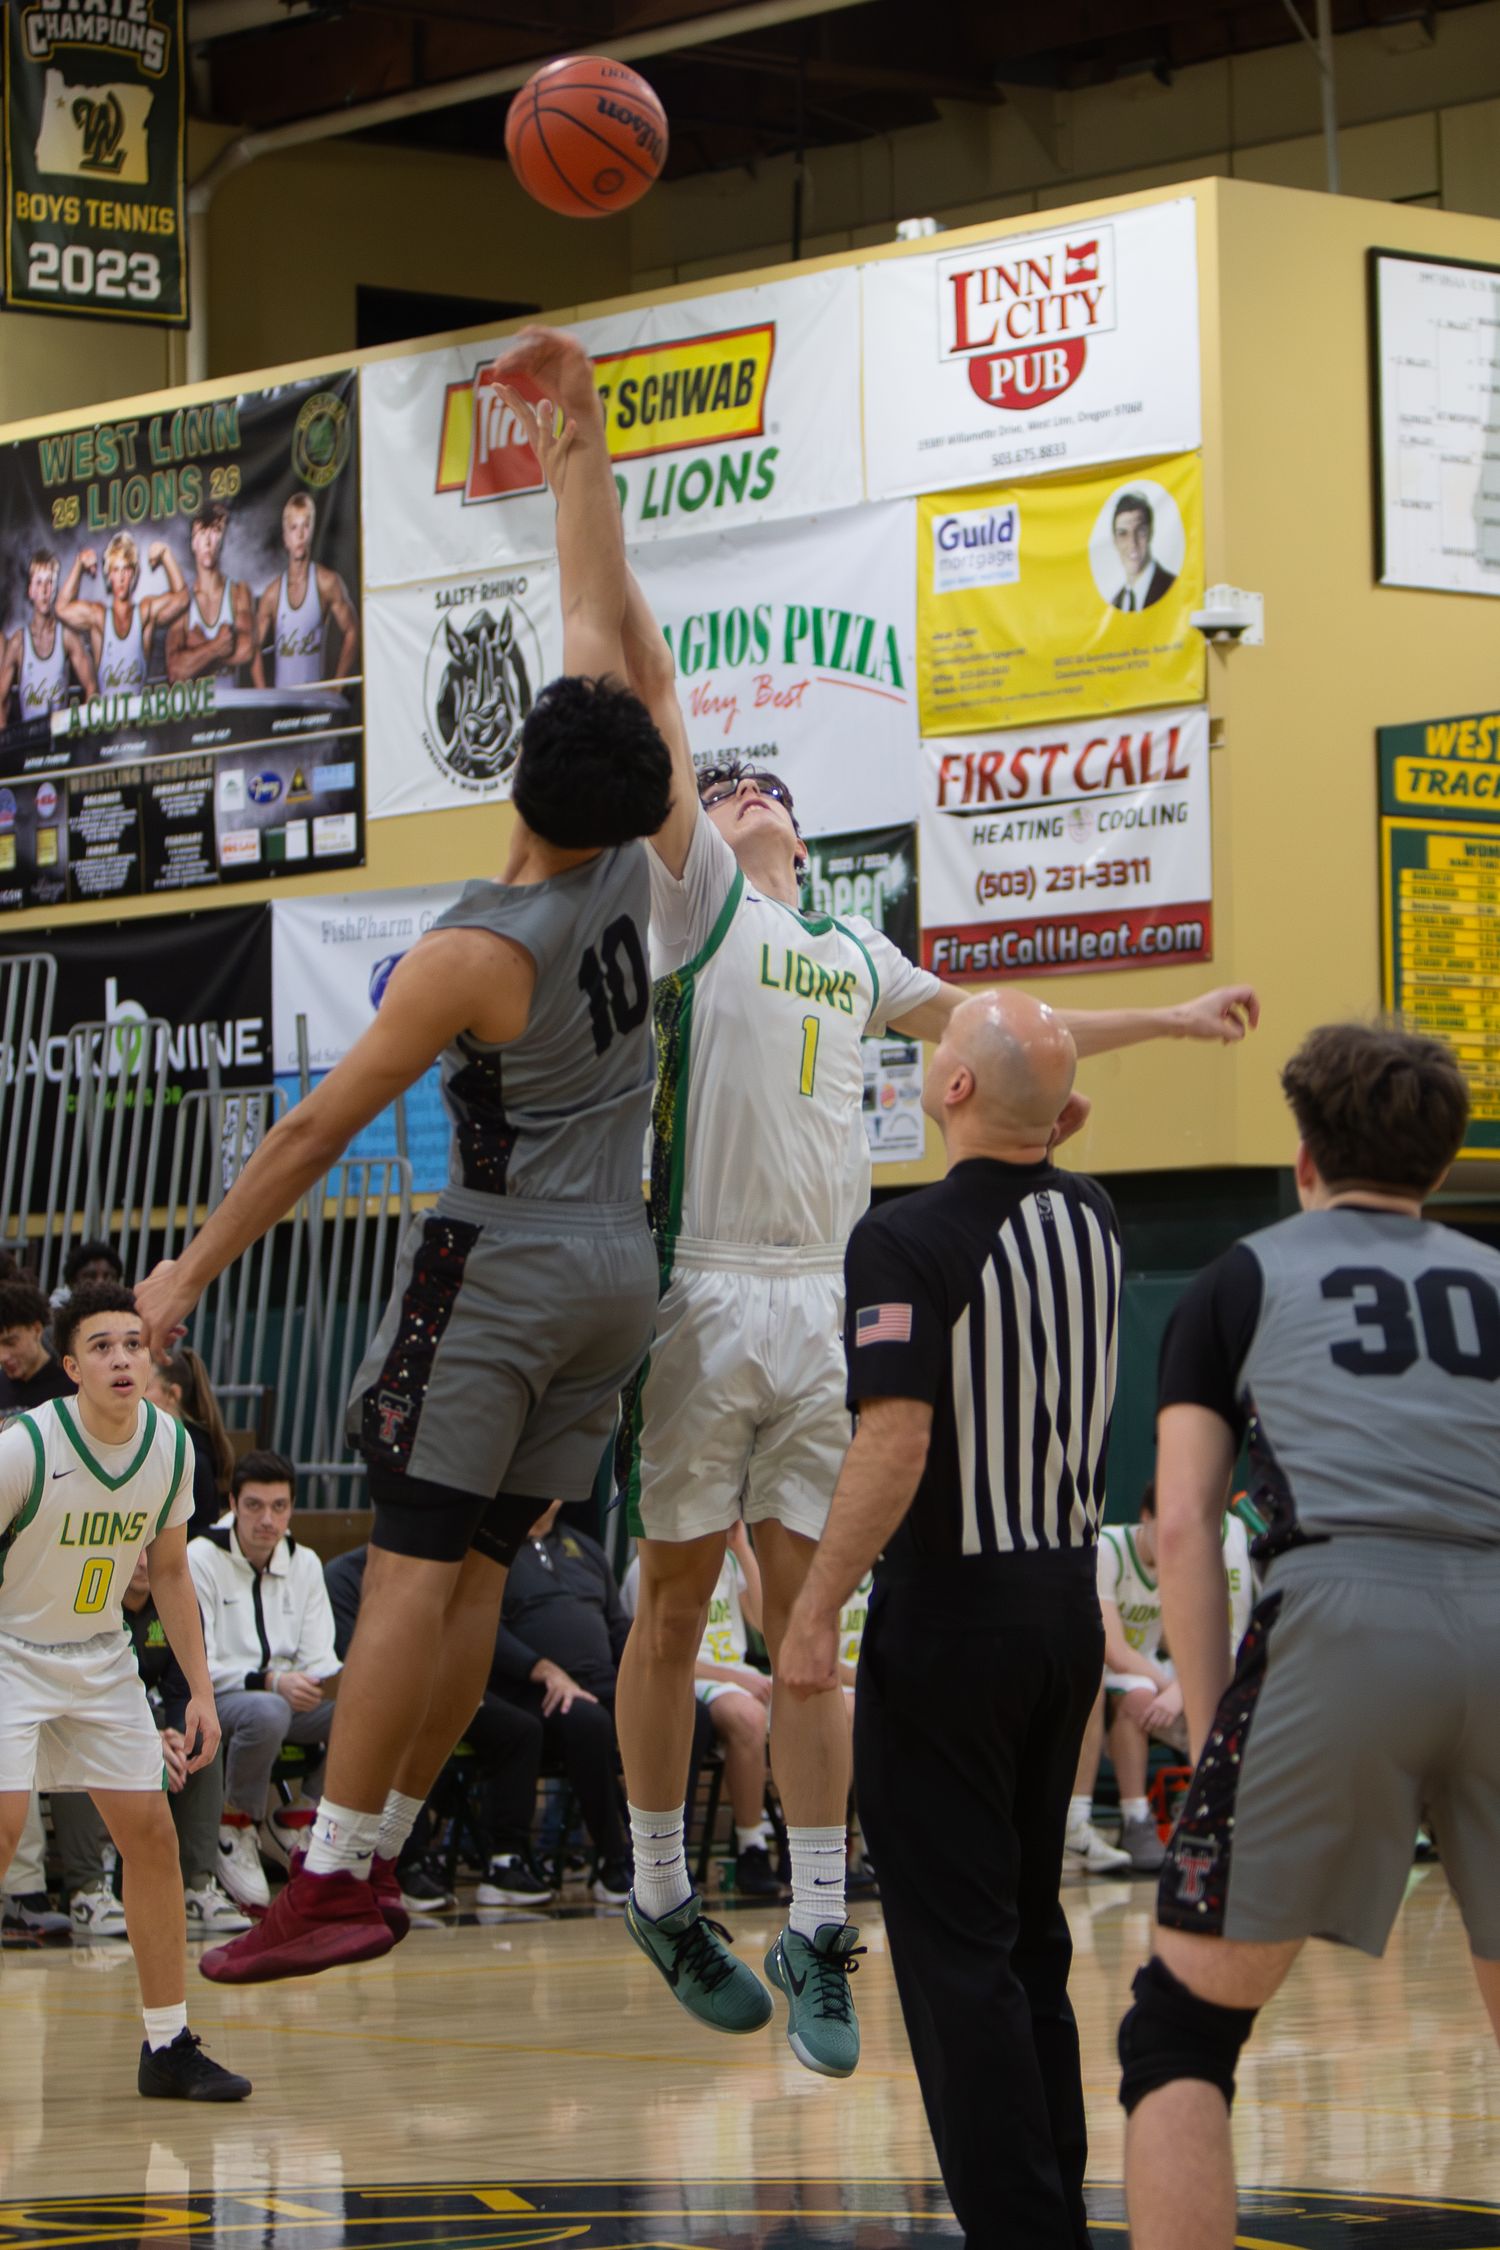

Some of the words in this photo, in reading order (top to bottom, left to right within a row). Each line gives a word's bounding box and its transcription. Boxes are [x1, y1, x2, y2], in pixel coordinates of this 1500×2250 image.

[27, 12, 166, 72] CHAMPIONS
[16, 191, 81, 226] BOYS
[85, 199, 176, 236] TENNIS
[28, 241, 162, 300] 2023
[949, 254, 1054, 353] LINN
[1006, 286, 1107, 340] CITY
[617, 358, 757, 429] SCHWAB
[988, 348, 1070, 401] PUB
[38, 421, 140, 488] WEST
[148, 402, 243, 466] LINN
[86, 465, 206, 532] LIONS
[640, 447, 780, 520] LIONS
[937, 510, 1014, 551] Guild
[938, 549, 1014, 573] mortgage
[782, 603, 907, 691] PIZZA
[86, 692, 133, 736] CUT
[136, 676, 218, 727] ABOVE
[689, 679, 738, 736] Very
[752, 673, 811, 710] Best
[936, 742, 1069, 808] FIRST
[1072, 726, 1190, 792] CALL
[1408, 766, 1500, 799] TRAC
[972, 817, 1065, 847] HEATING
[1097, 801, 1189, 833] COOLING
[975, 865, 1037, 906] (503)
[1045, 857, 1152, 894] 231-3311
[931, 920, 1205, 973] FirstCallHeat.com
[578, 912, 649, 1058] 10
[760, 943, 858, 1016] LIONS
[155, 1017, 264, 1073] NINE
[799, 1014, 821, 1098] 1
[1319, 1264, 1500, 1383] 30
[60, 1511, 147, 1547] LIONS
[73, 1556, 115, 1615] 0
